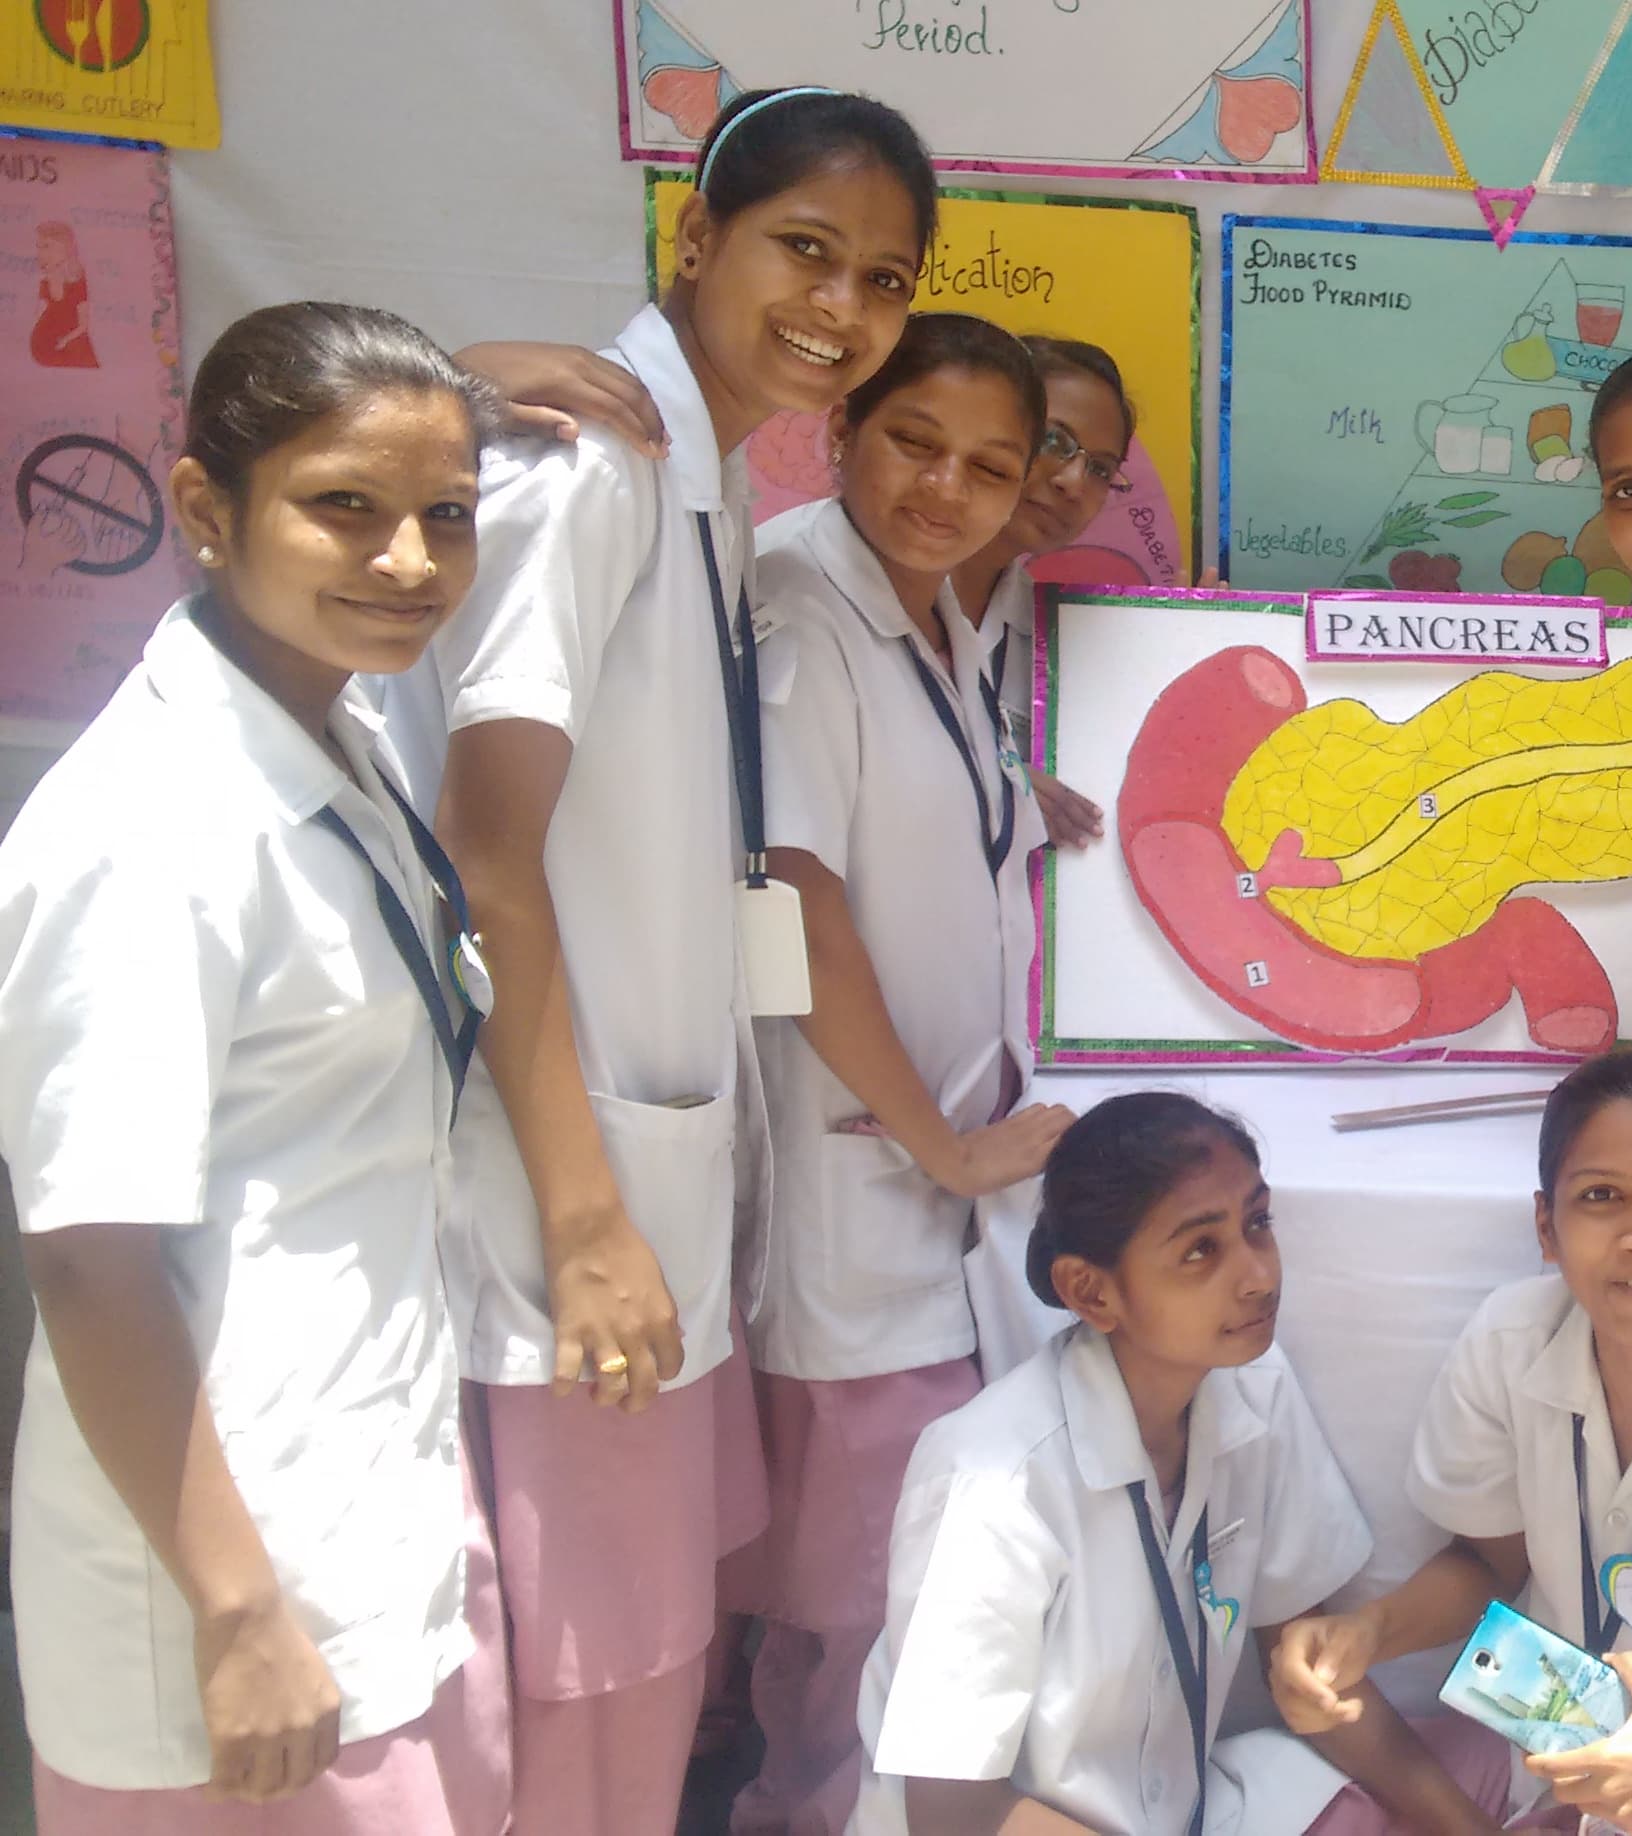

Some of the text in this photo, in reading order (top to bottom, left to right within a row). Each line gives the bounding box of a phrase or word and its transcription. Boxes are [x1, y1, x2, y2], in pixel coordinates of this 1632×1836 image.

[1424, 0, 1538, 105] Diab
[81, 94, 165, 118] CUTLERY
[916, 230, 1054, 303] lication
[1244, 239, 1357, 271] DIABETES
[1241, 272, 1412, 311] FOOD PYRAMID
[1326, 406, 1384, 444] Milk
[1325, 613, 1591, 653] PANCREAS
[1422, 798, 1434, 813] 3
[1241, 877, 1254, 893] 2
[1252, 966, 1264, 983] 1
